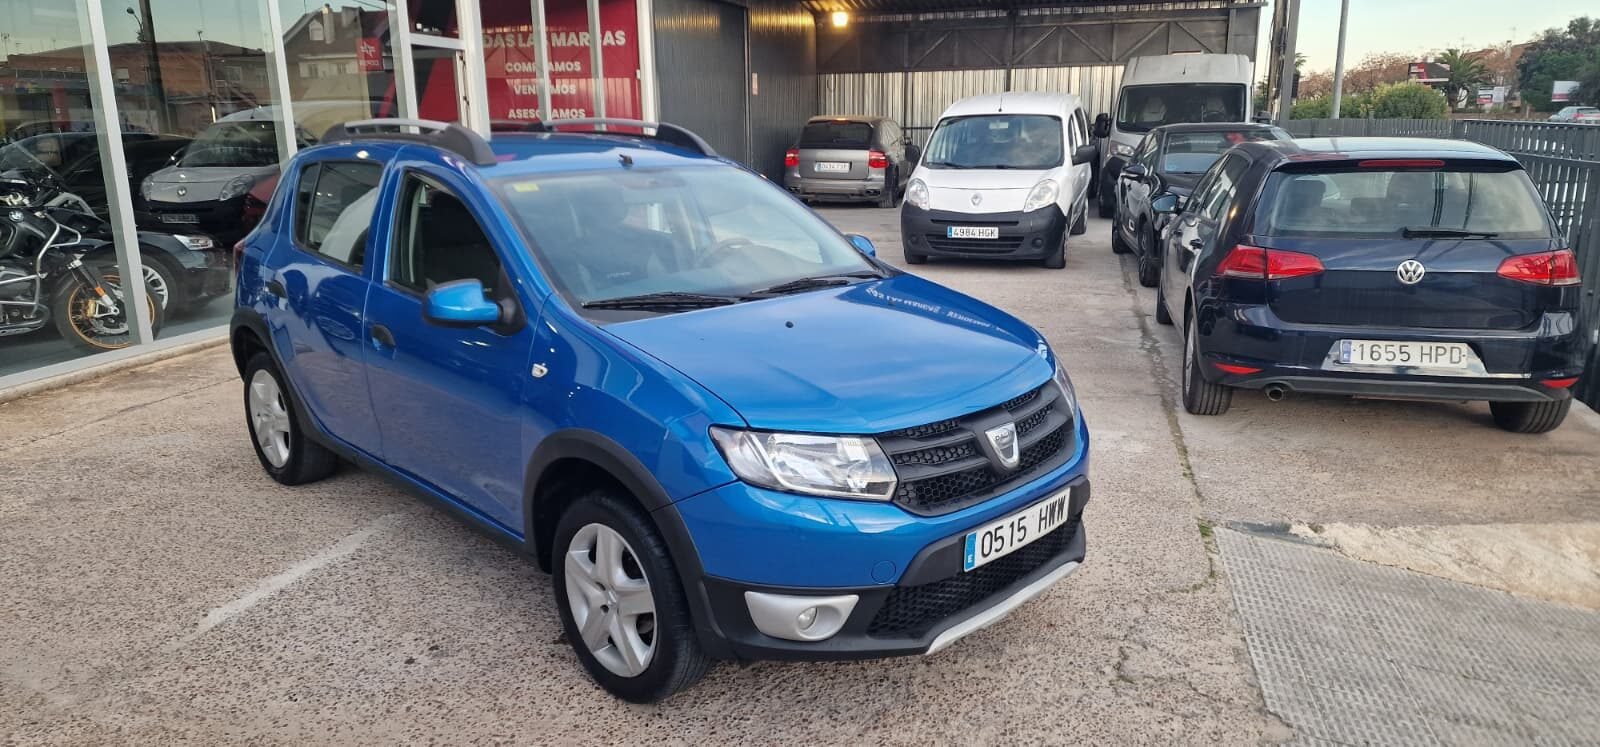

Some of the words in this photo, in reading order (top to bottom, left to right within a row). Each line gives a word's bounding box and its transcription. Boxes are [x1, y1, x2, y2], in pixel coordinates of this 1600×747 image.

[482, 33, 515, 48] DAS
[551, 30, 626, 47] MARAS
[505, 61, 581, 72] COMPAMOS
[513, 84, 577, 95] VENMOS
[508, 108, 586, 119] ASESOAMOS
[953, 228, 976, 237] 4984
[1358, 343, 1411, 362] 1655
[1420, 345, 1462, 365] HPD
[981, 515, 1027, 558] 0515
[1038, 495, 1066, 533] HWW
